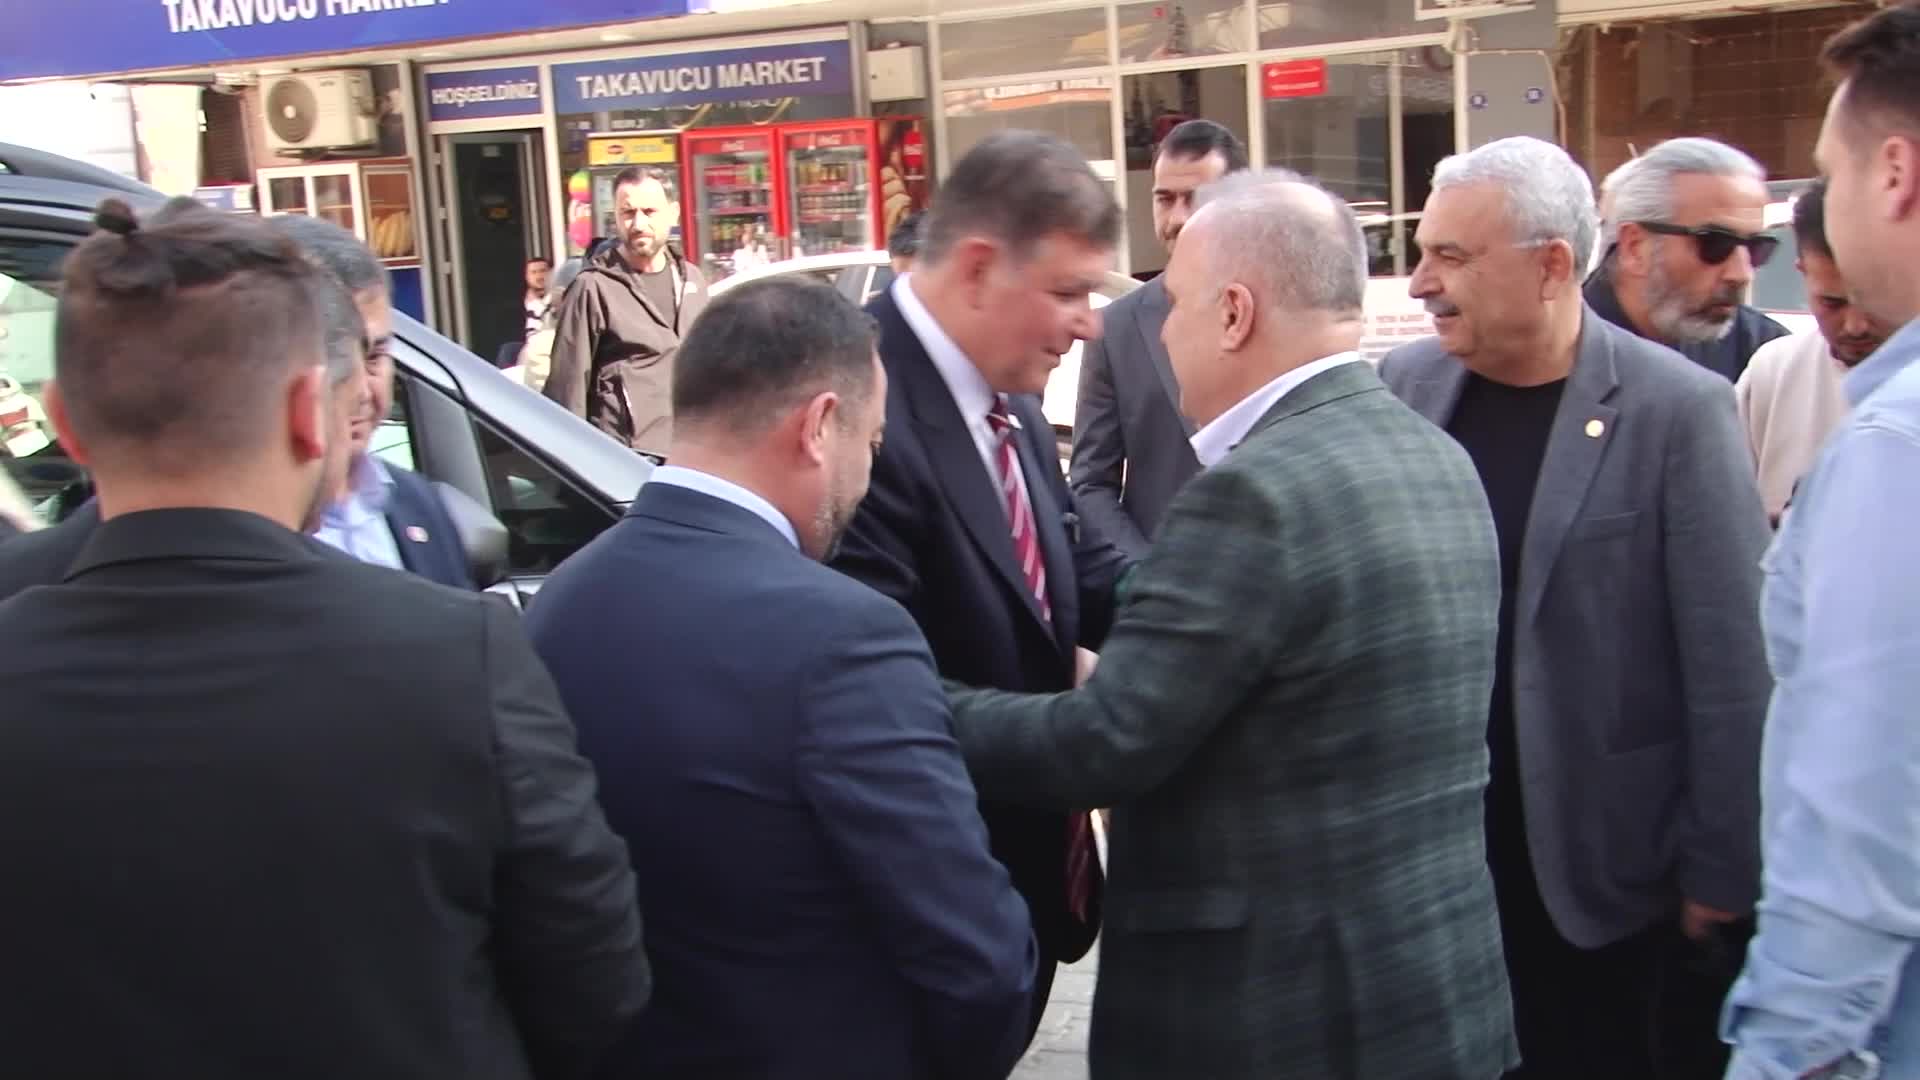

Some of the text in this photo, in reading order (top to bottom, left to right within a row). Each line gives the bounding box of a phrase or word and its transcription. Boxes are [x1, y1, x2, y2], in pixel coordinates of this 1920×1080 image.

[162, 0, 318, 33] TAKAVUCU
[575, 56, 826, 100] TAKAVUCU MARKET
